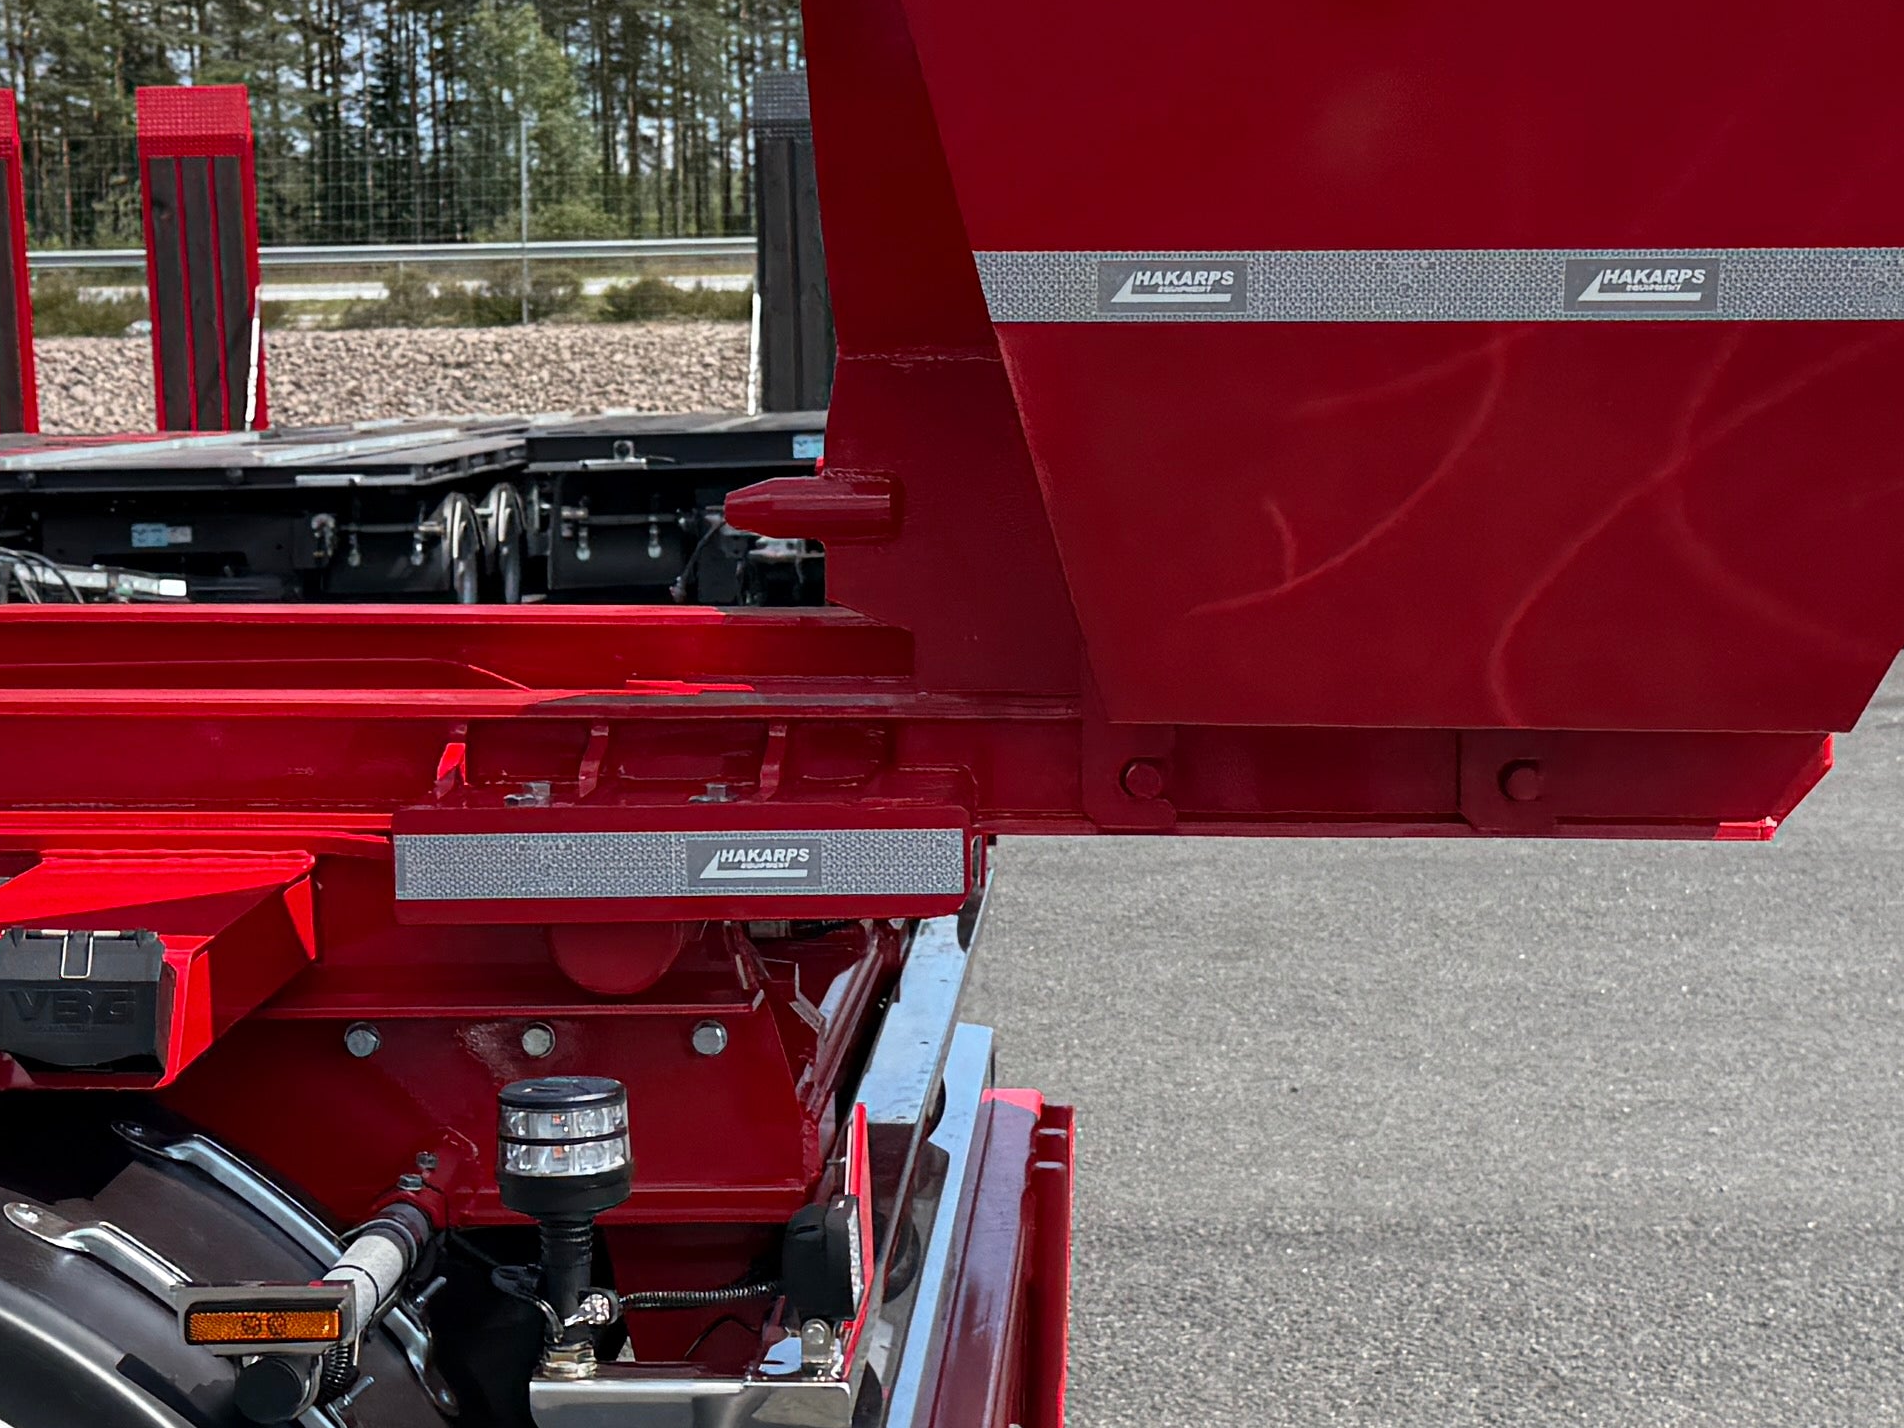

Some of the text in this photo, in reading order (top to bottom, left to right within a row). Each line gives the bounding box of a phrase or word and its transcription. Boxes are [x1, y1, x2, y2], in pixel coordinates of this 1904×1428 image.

[1135, 270, 1234, 286] HAKARPS
[1603, 269, 1706, 284] HAKARPS
[719, 848, 810, 863] HAKARPS
[6, 988, 137, 1023] VBG
